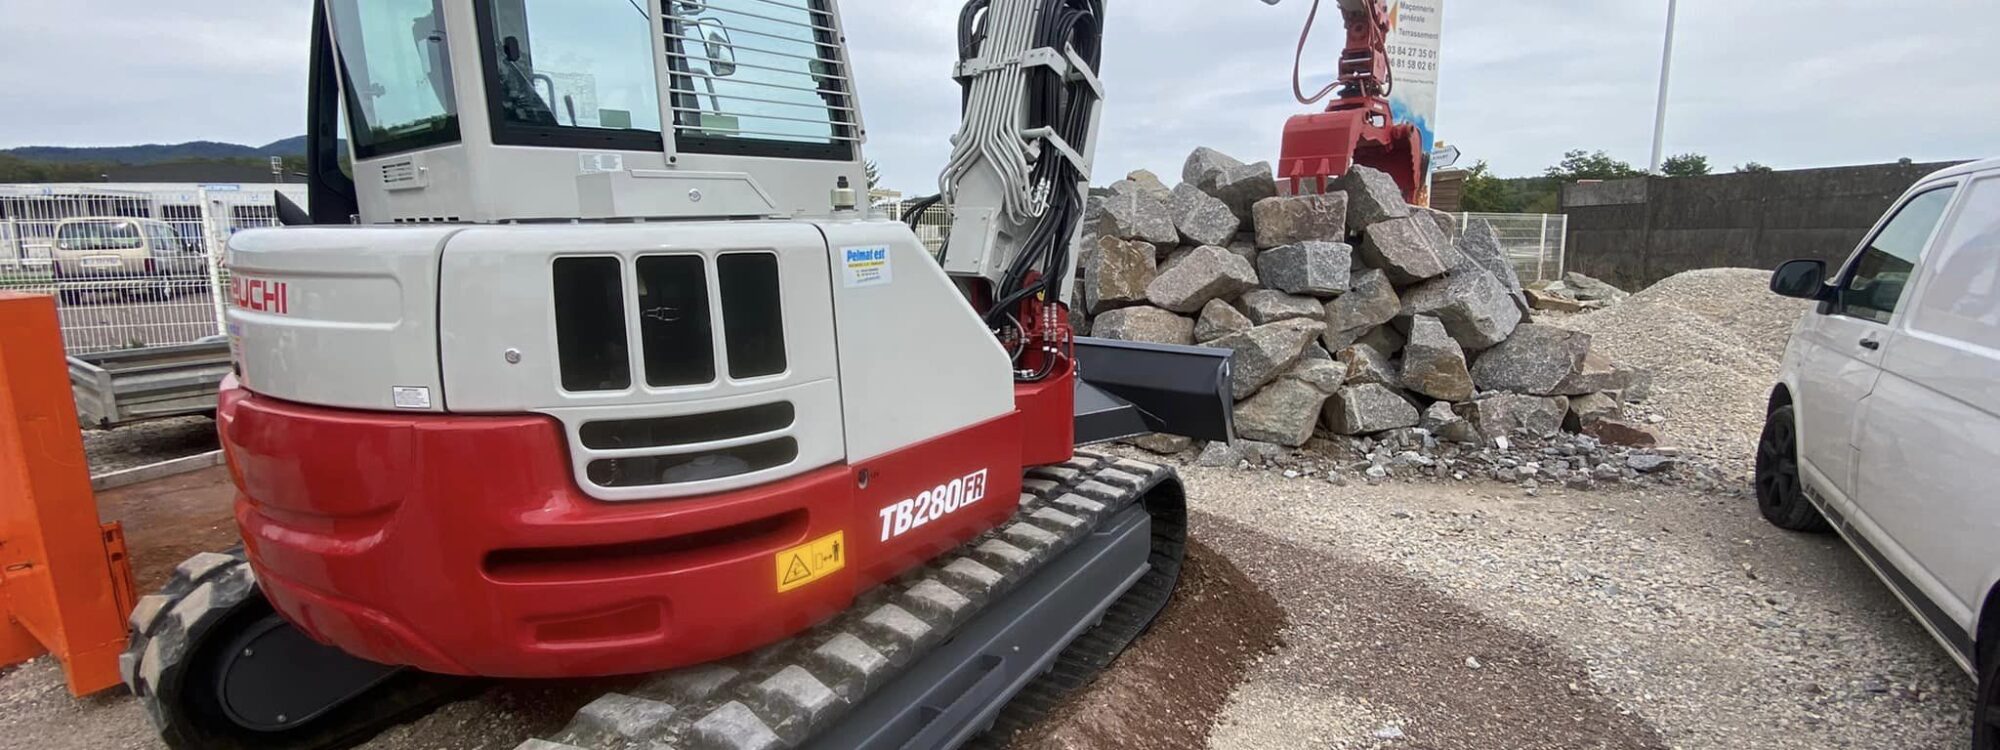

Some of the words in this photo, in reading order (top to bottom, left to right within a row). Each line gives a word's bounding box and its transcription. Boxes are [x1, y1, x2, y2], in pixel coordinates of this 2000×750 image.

[1400, 2, 1434, 12] Maçonnerie
[1400, 14, 1424, 22] générale
[1399, 28, 1438, 39] Terrassement
[1387, 45, 1396, 55] 03
[1397, 46, 1406, 55] 84
[1408, 47, 1417, 57] 27
[1418, 48, 1427, 58] 35
[1428, 49, 1437, 59] 01
[1397, 58, 1405, 68] 81
[1408, 59, 1416, 69] 58
[1417, 60, 1426, 70] 02
[1428, 62, 1436, 71] 61
[874, 248, 884, 260] est
